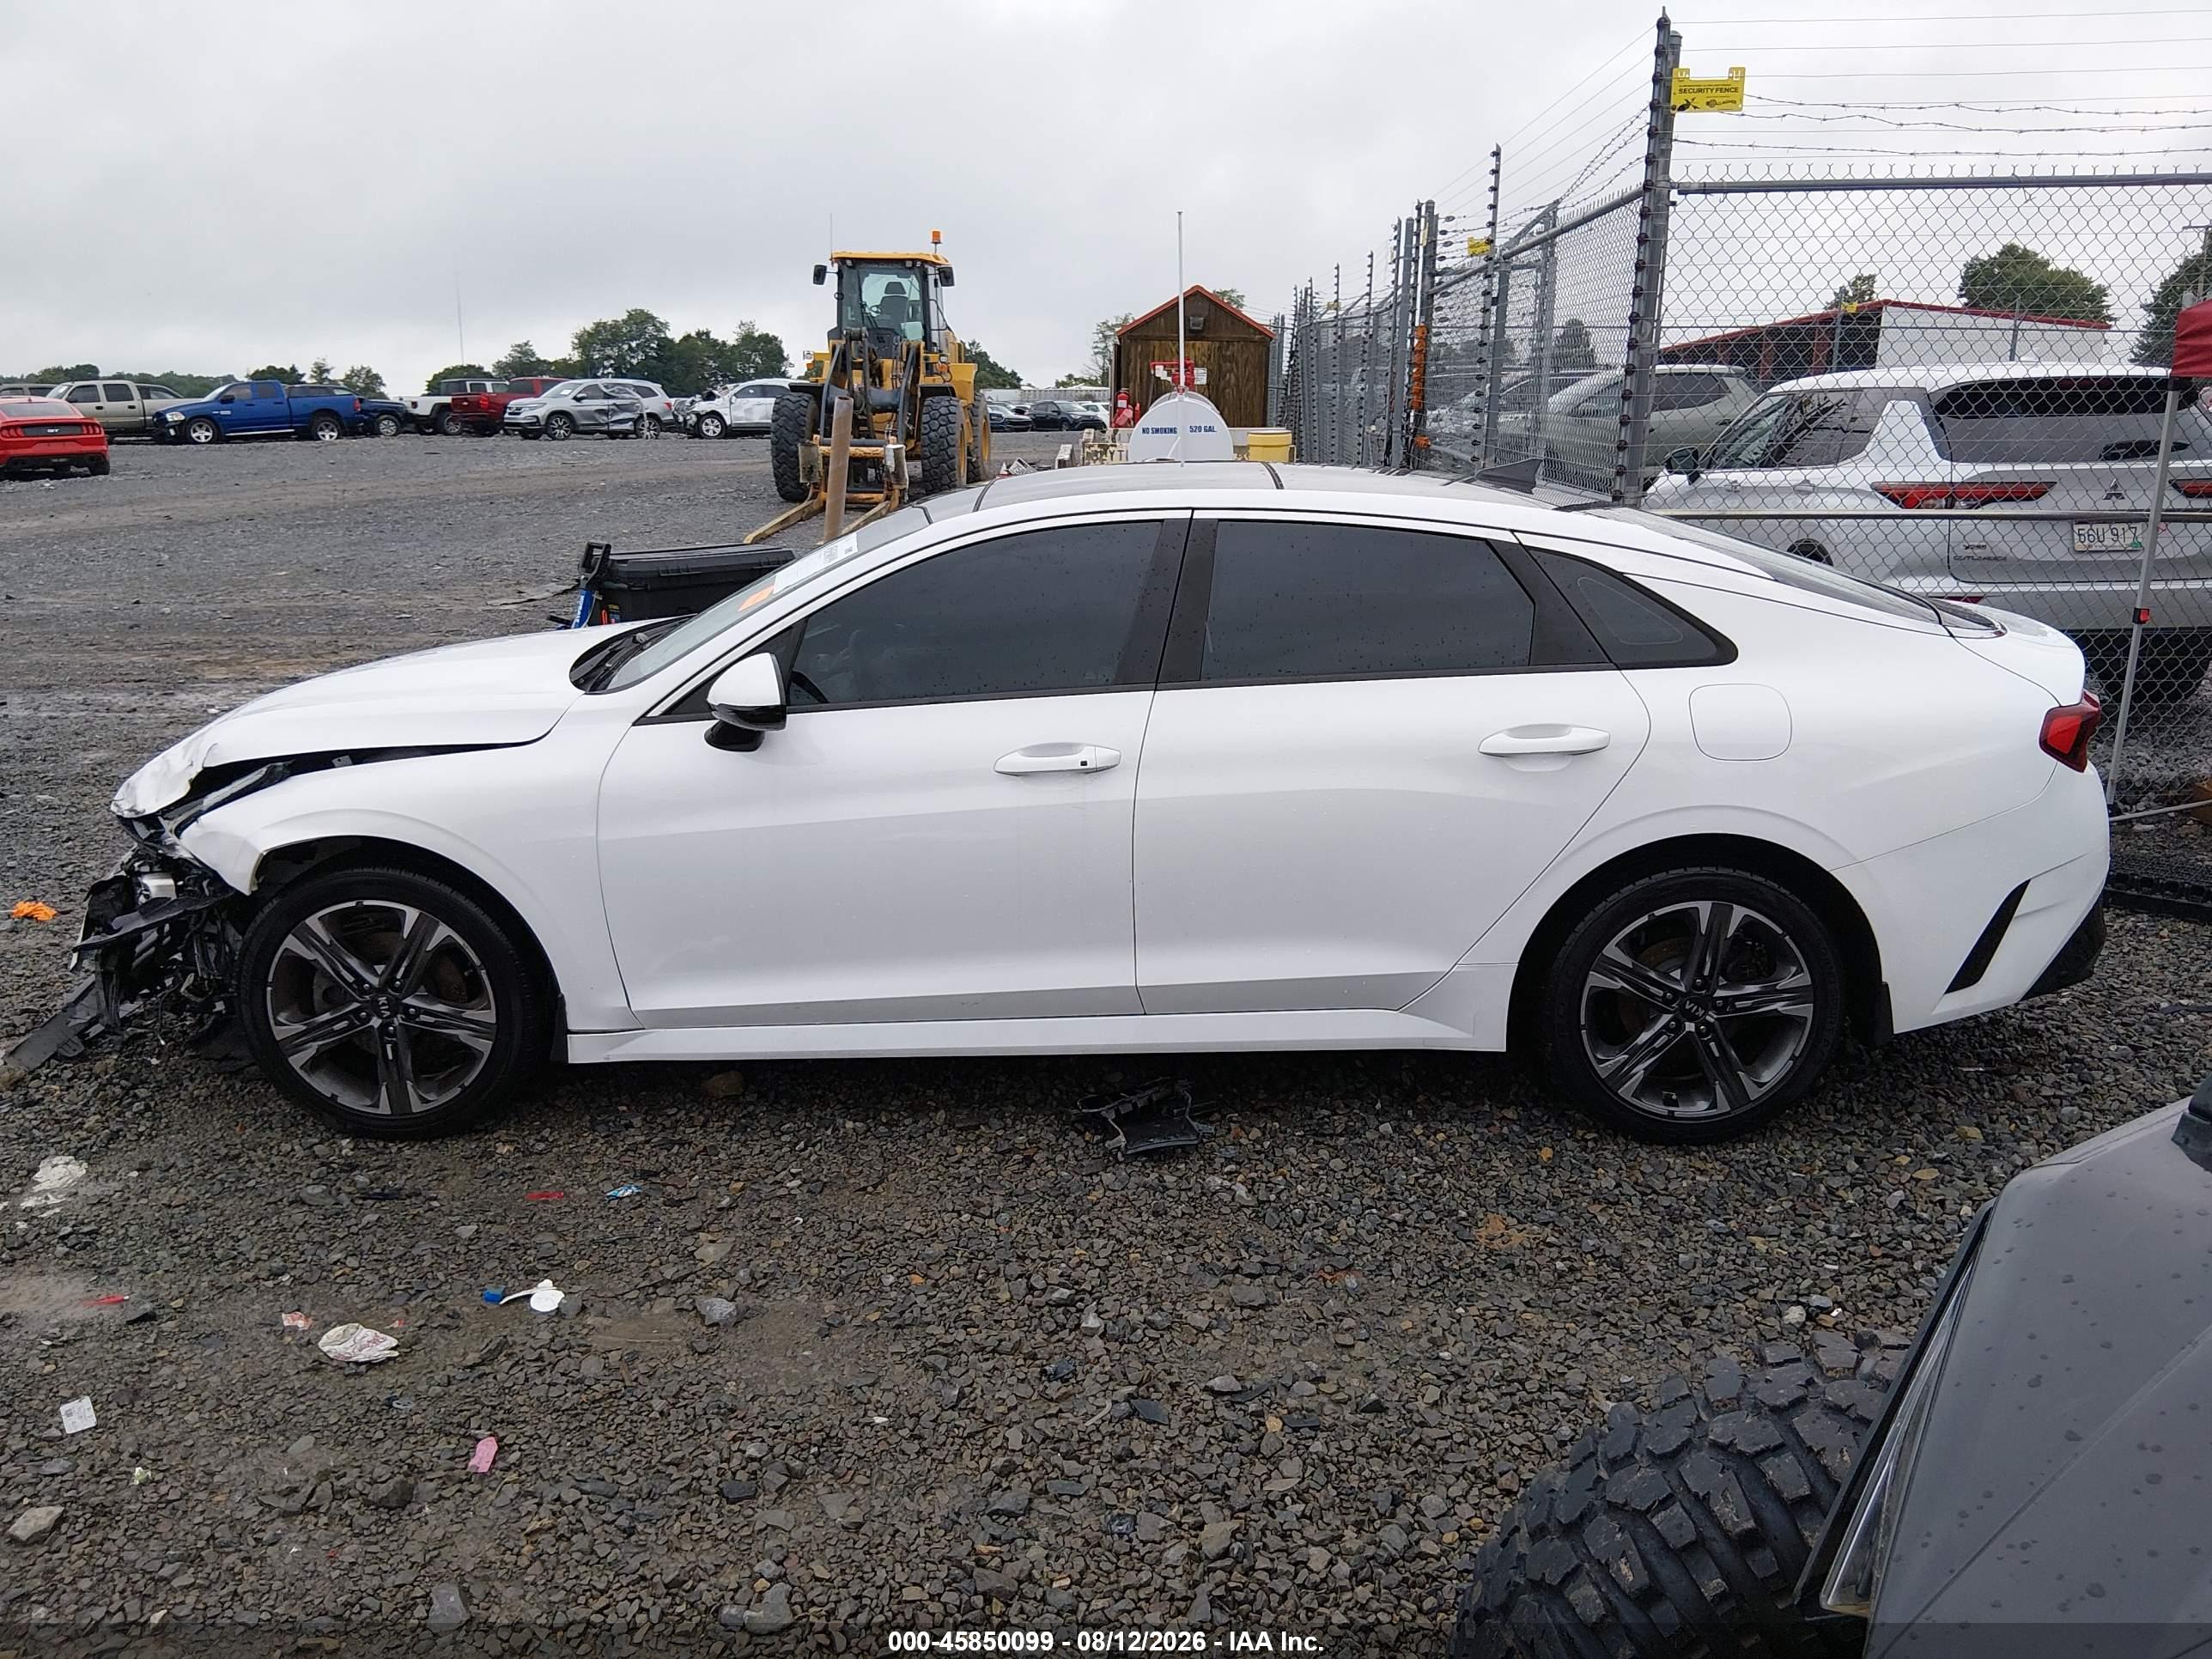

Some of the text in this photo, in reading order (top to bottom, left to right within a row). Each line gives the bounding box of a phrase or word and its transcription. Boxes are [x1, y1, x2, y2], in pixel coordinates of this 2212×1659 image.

[2110, 526, 2137, 544] 917
[378, 996, 391, 1018] KIA
[1685, 1000, 1705, 1018] KIA
